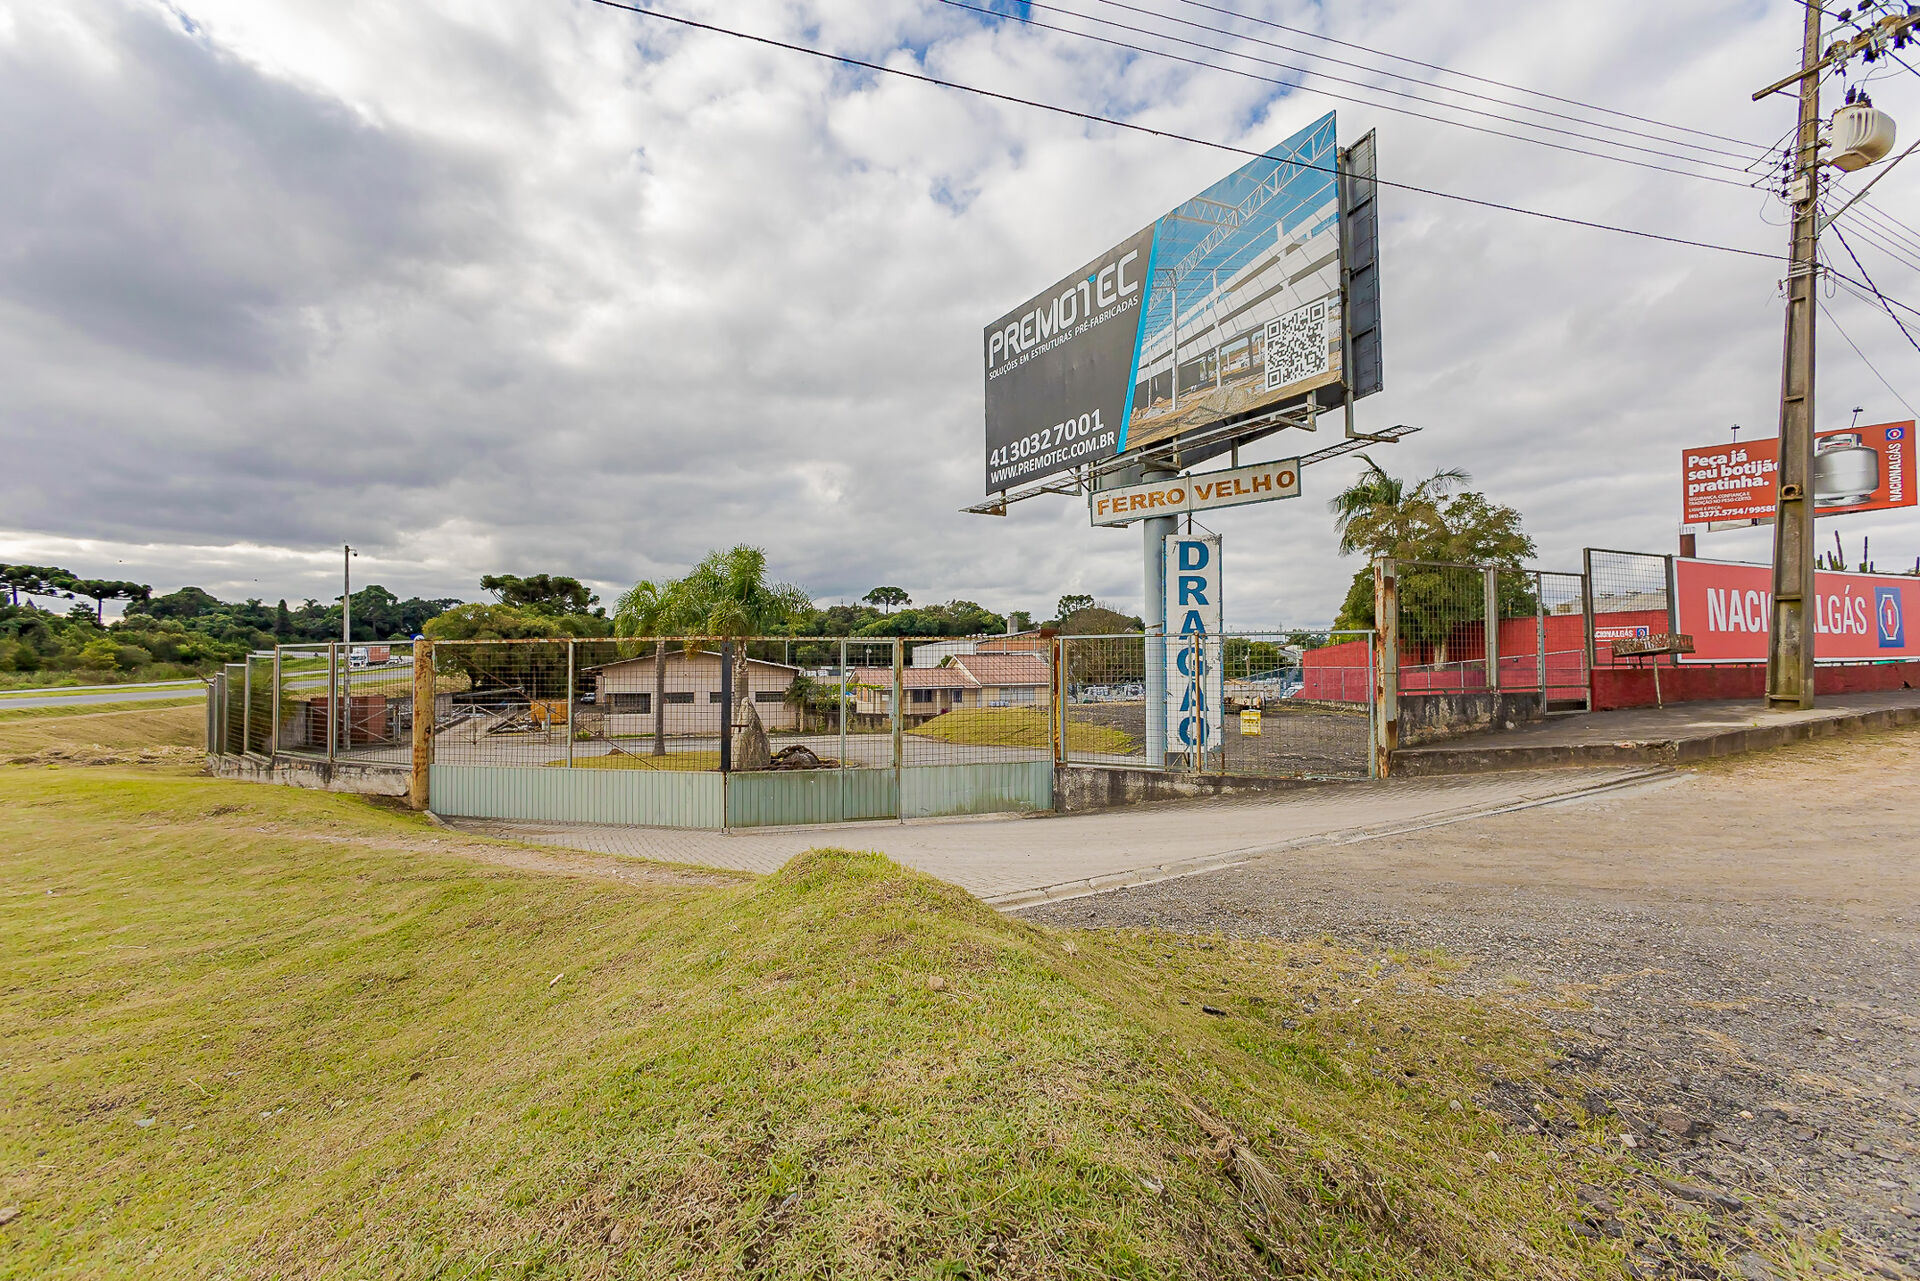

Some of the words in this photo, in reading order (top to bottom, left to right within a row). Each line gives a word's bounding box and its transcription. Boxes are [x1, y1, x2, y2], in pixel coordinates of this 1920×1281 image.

[988, 249, 1139, 369] PREMOTEC
[989, 358, 1018, 381] SOLUÇÕES
[1019, 353, 1030, 365] EM
[1031, 329, 1073, 359] ESTRUTURAS
[1074, 294, 1139, 337] PRÉ-FABRICADAS
[990, 431, 1115, 484] WWW.PREMOTEC.COM.BR
[1688, 454, 1728, 469] Peça
[1729, 448, 1748, 466] já
[1688, 467, 1718, 481] seu
[1885, 443, 1902, 502] NACIONALGÁS
[1097, 487, 1186, 516] FERRO
[1194, 470, 1296, 501] VELHO
[1688, 475, 1770, 497] pratinha.
